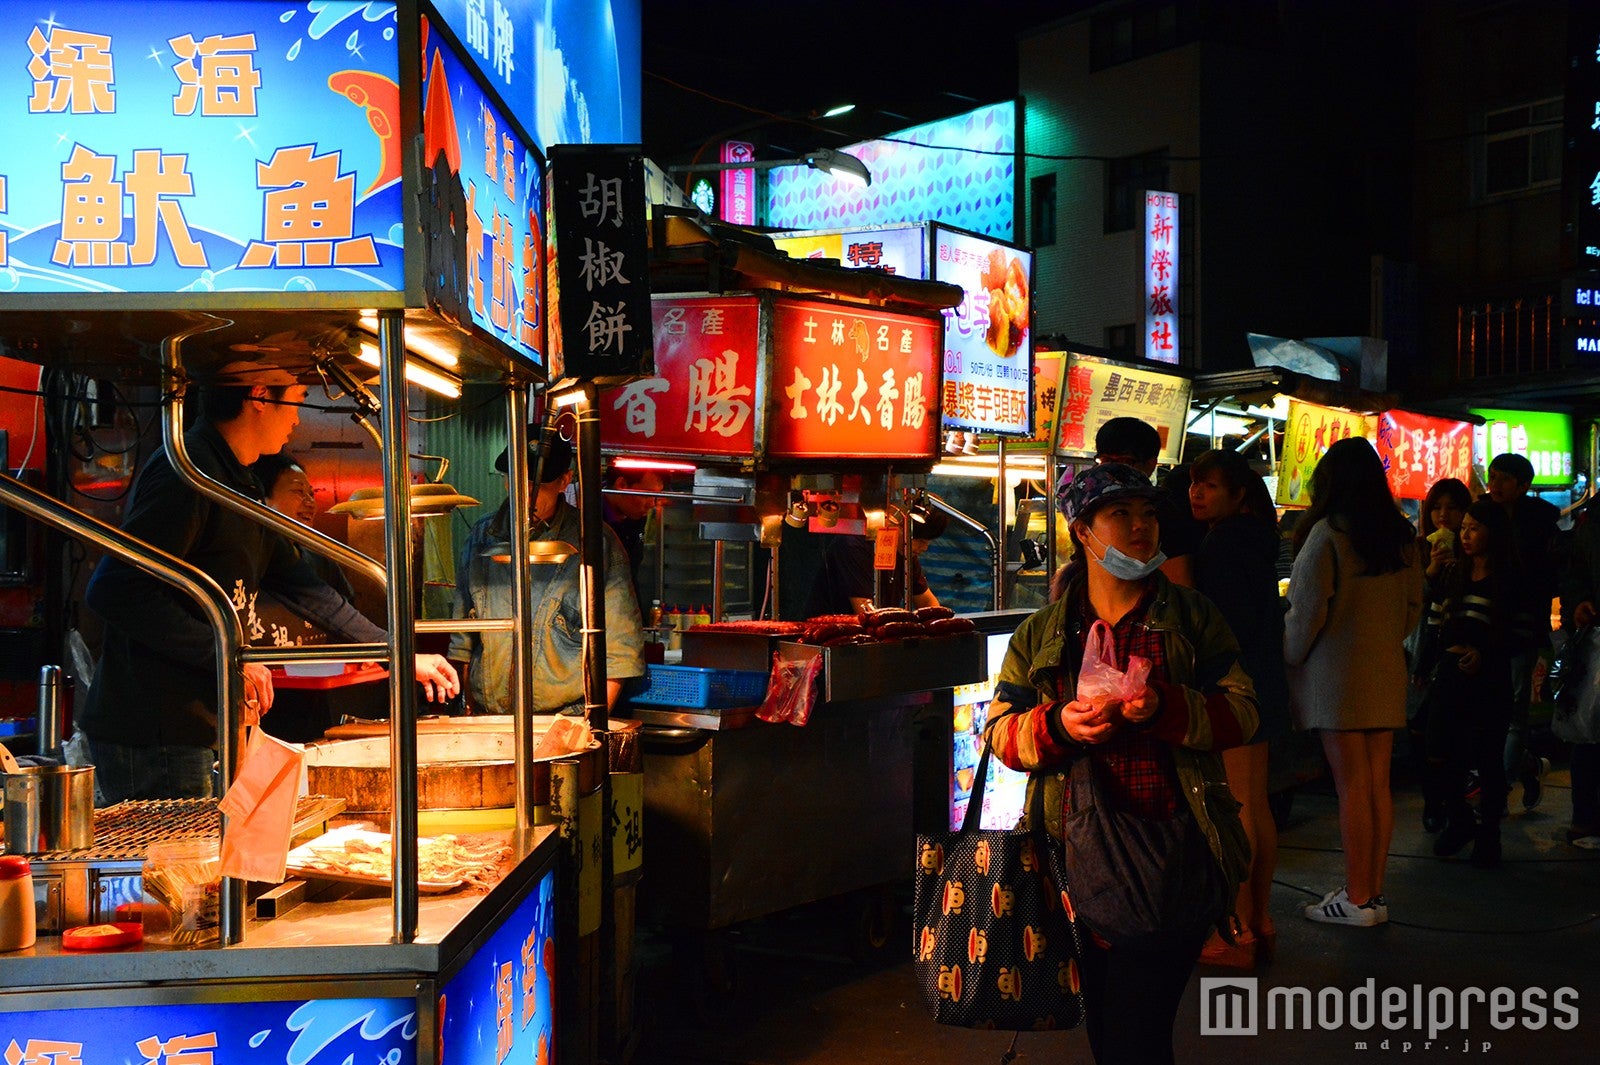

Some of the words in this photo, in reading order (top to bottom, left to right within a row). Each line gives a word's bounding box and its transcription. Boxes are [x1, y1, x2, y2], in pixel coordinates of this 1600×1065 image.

[27, 26, 262, 117] 深海
[483, 107, 516, 205] 深海
[1147, 194, 1178, 209] HOTEL
[0, 143, 381, 269] 魷魚
[578, 172, 633, 355] 胡椒餅
[1150, 213, 1174, 350] 新榮旅社
[664, 307, 724, 336] 名產
[803, 315, 913, 353] 士林名產
[785, 363, 926, 431] 士林大香腸
